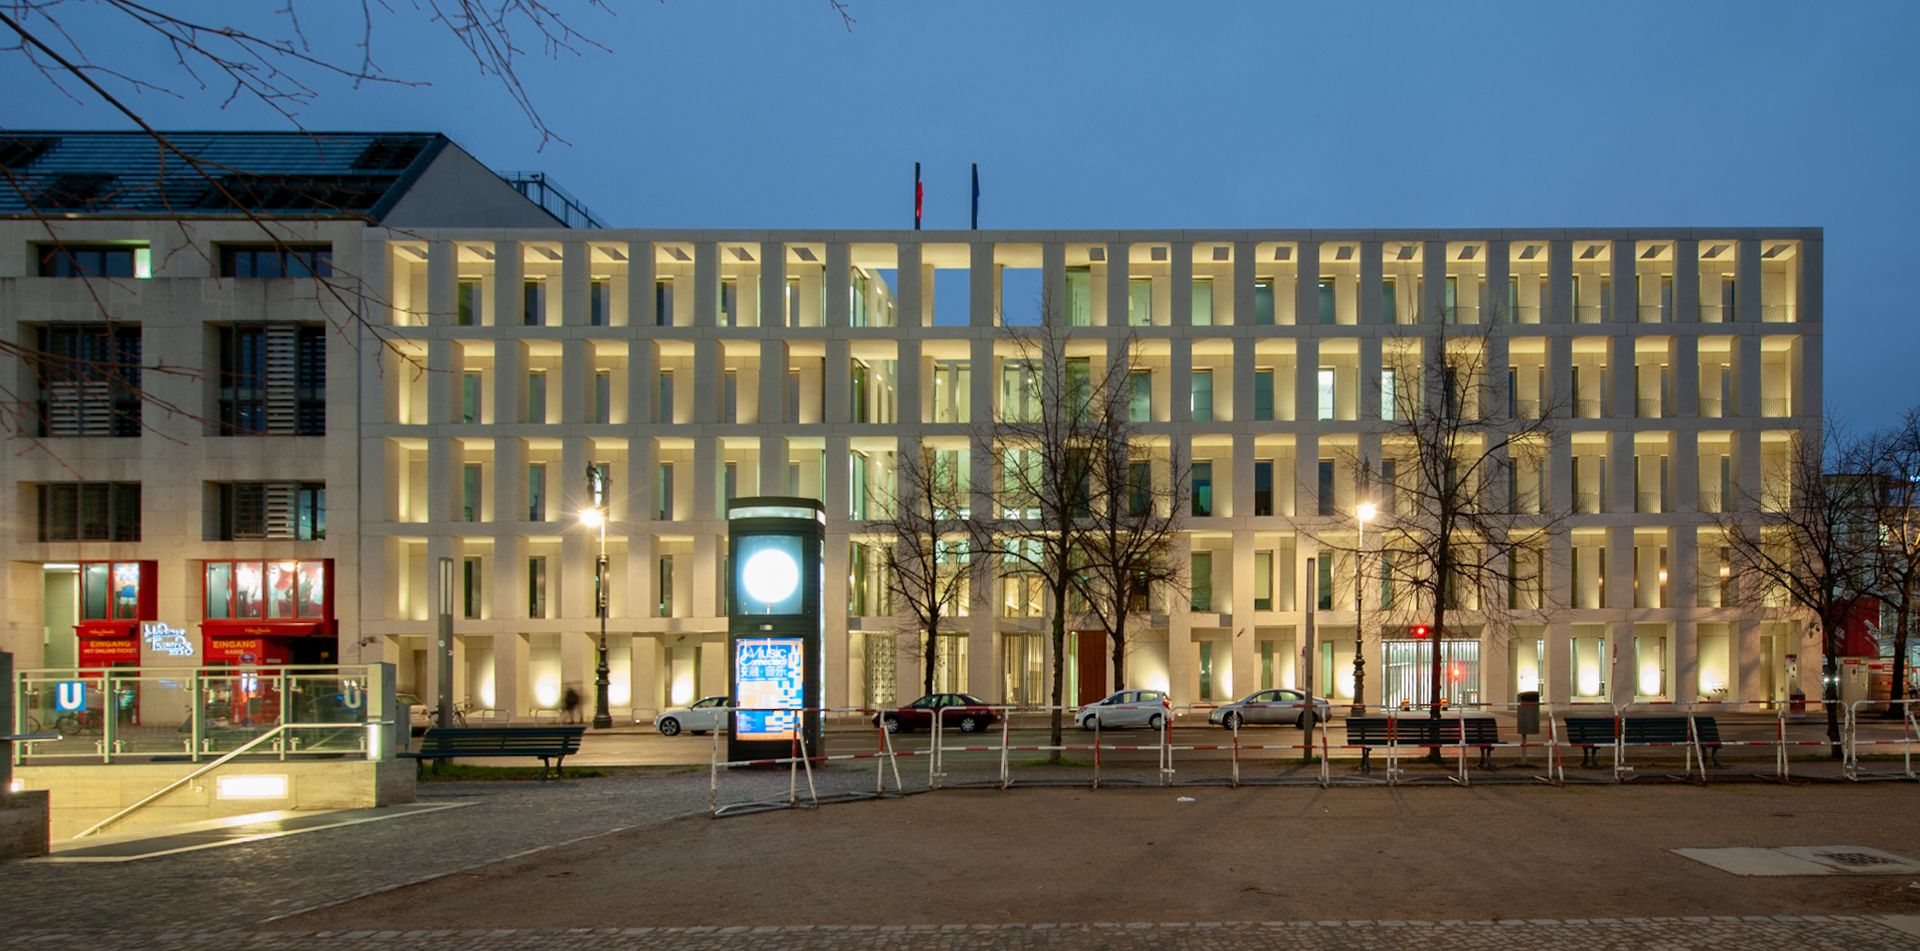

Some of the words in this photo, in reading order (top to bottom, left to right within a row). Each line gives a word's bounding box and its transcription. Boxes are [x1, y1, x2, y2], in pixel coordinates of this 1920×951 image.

[90, 640, 132, 648] EINGANG
[213, 640, 256, 648] EINGANG
[59, 683, 82, 710] U
[344, 687, 362, 709] U
